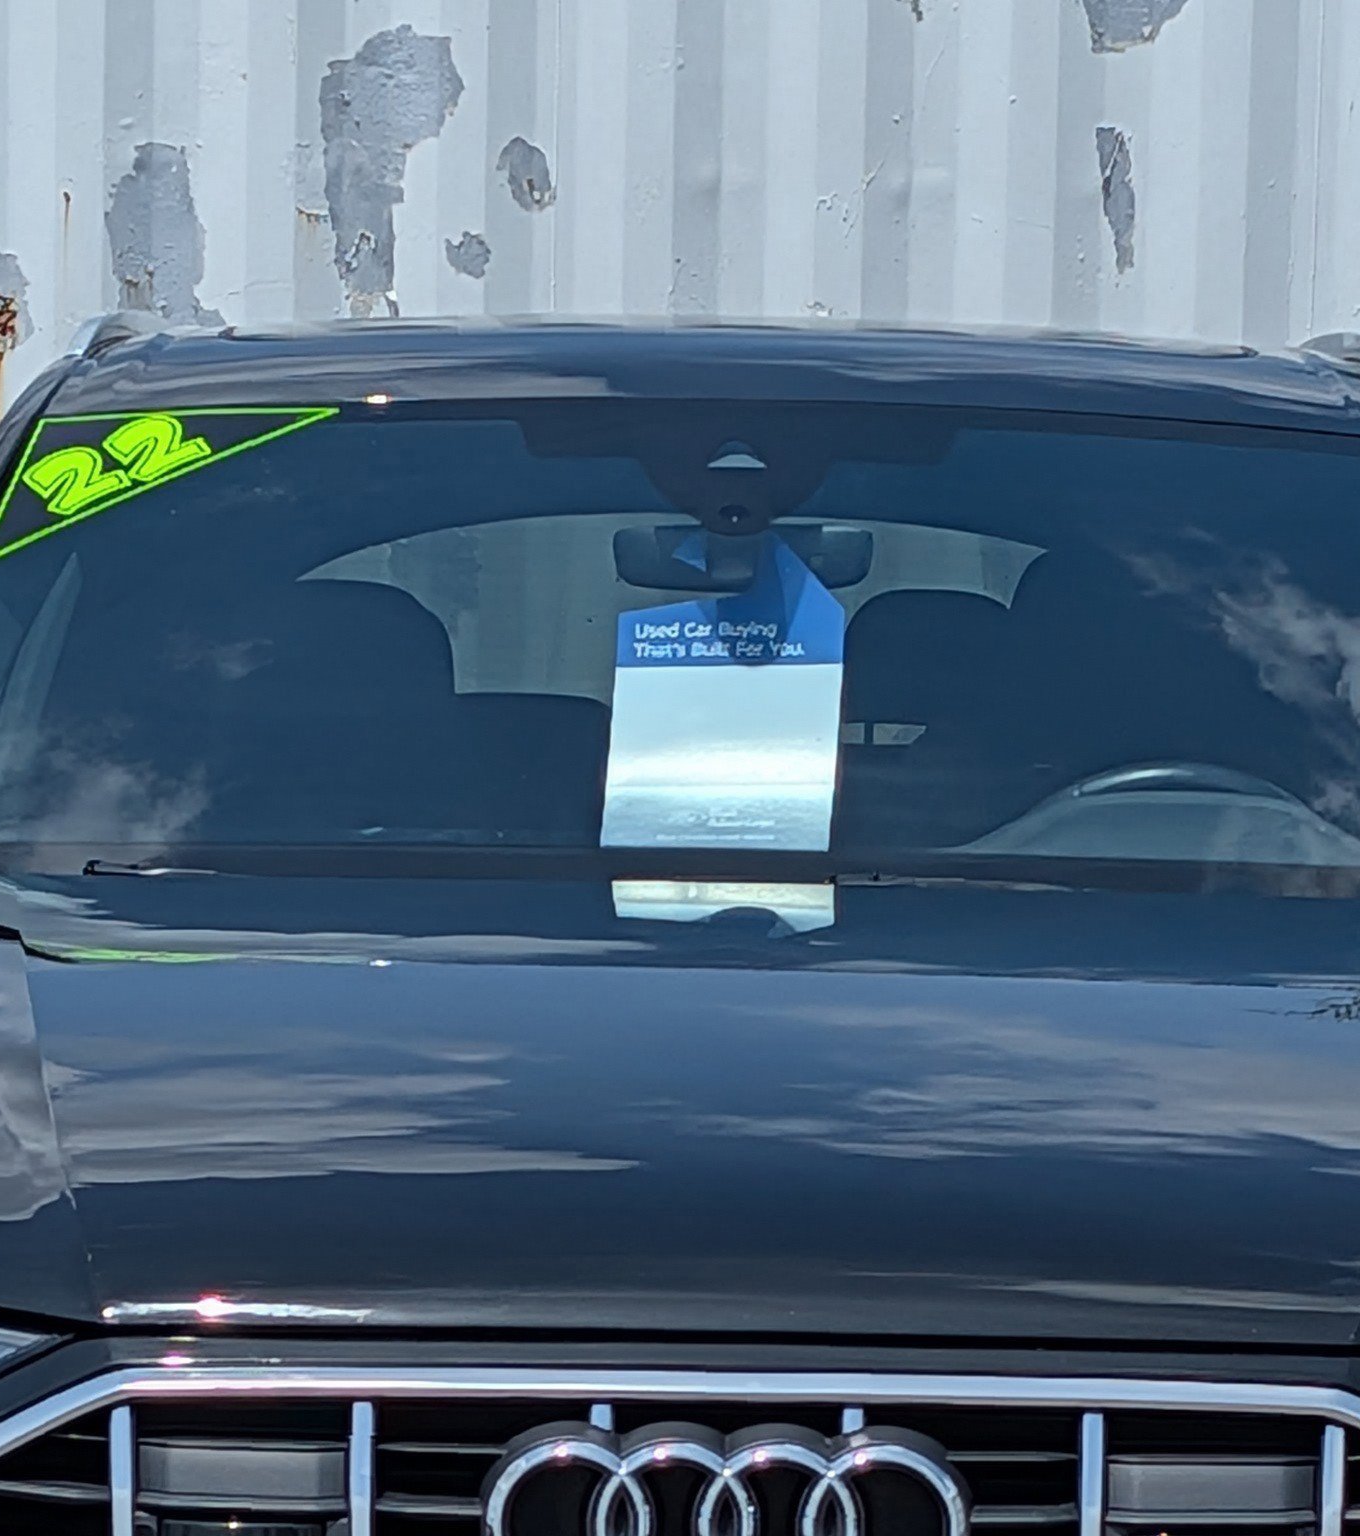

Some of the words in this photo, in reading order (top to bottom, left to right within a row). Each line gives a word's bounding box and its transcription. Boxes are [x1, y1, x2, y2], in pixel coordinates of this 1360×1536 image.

[22, 413, 212, 515] 22
[634, 621, 679, 638] Used
[683, 621, 713, 638] Car
[718, 621, 778, 639] Buying
[633, 641, 686, 658] That's
[735, 641, 764, 658] For
